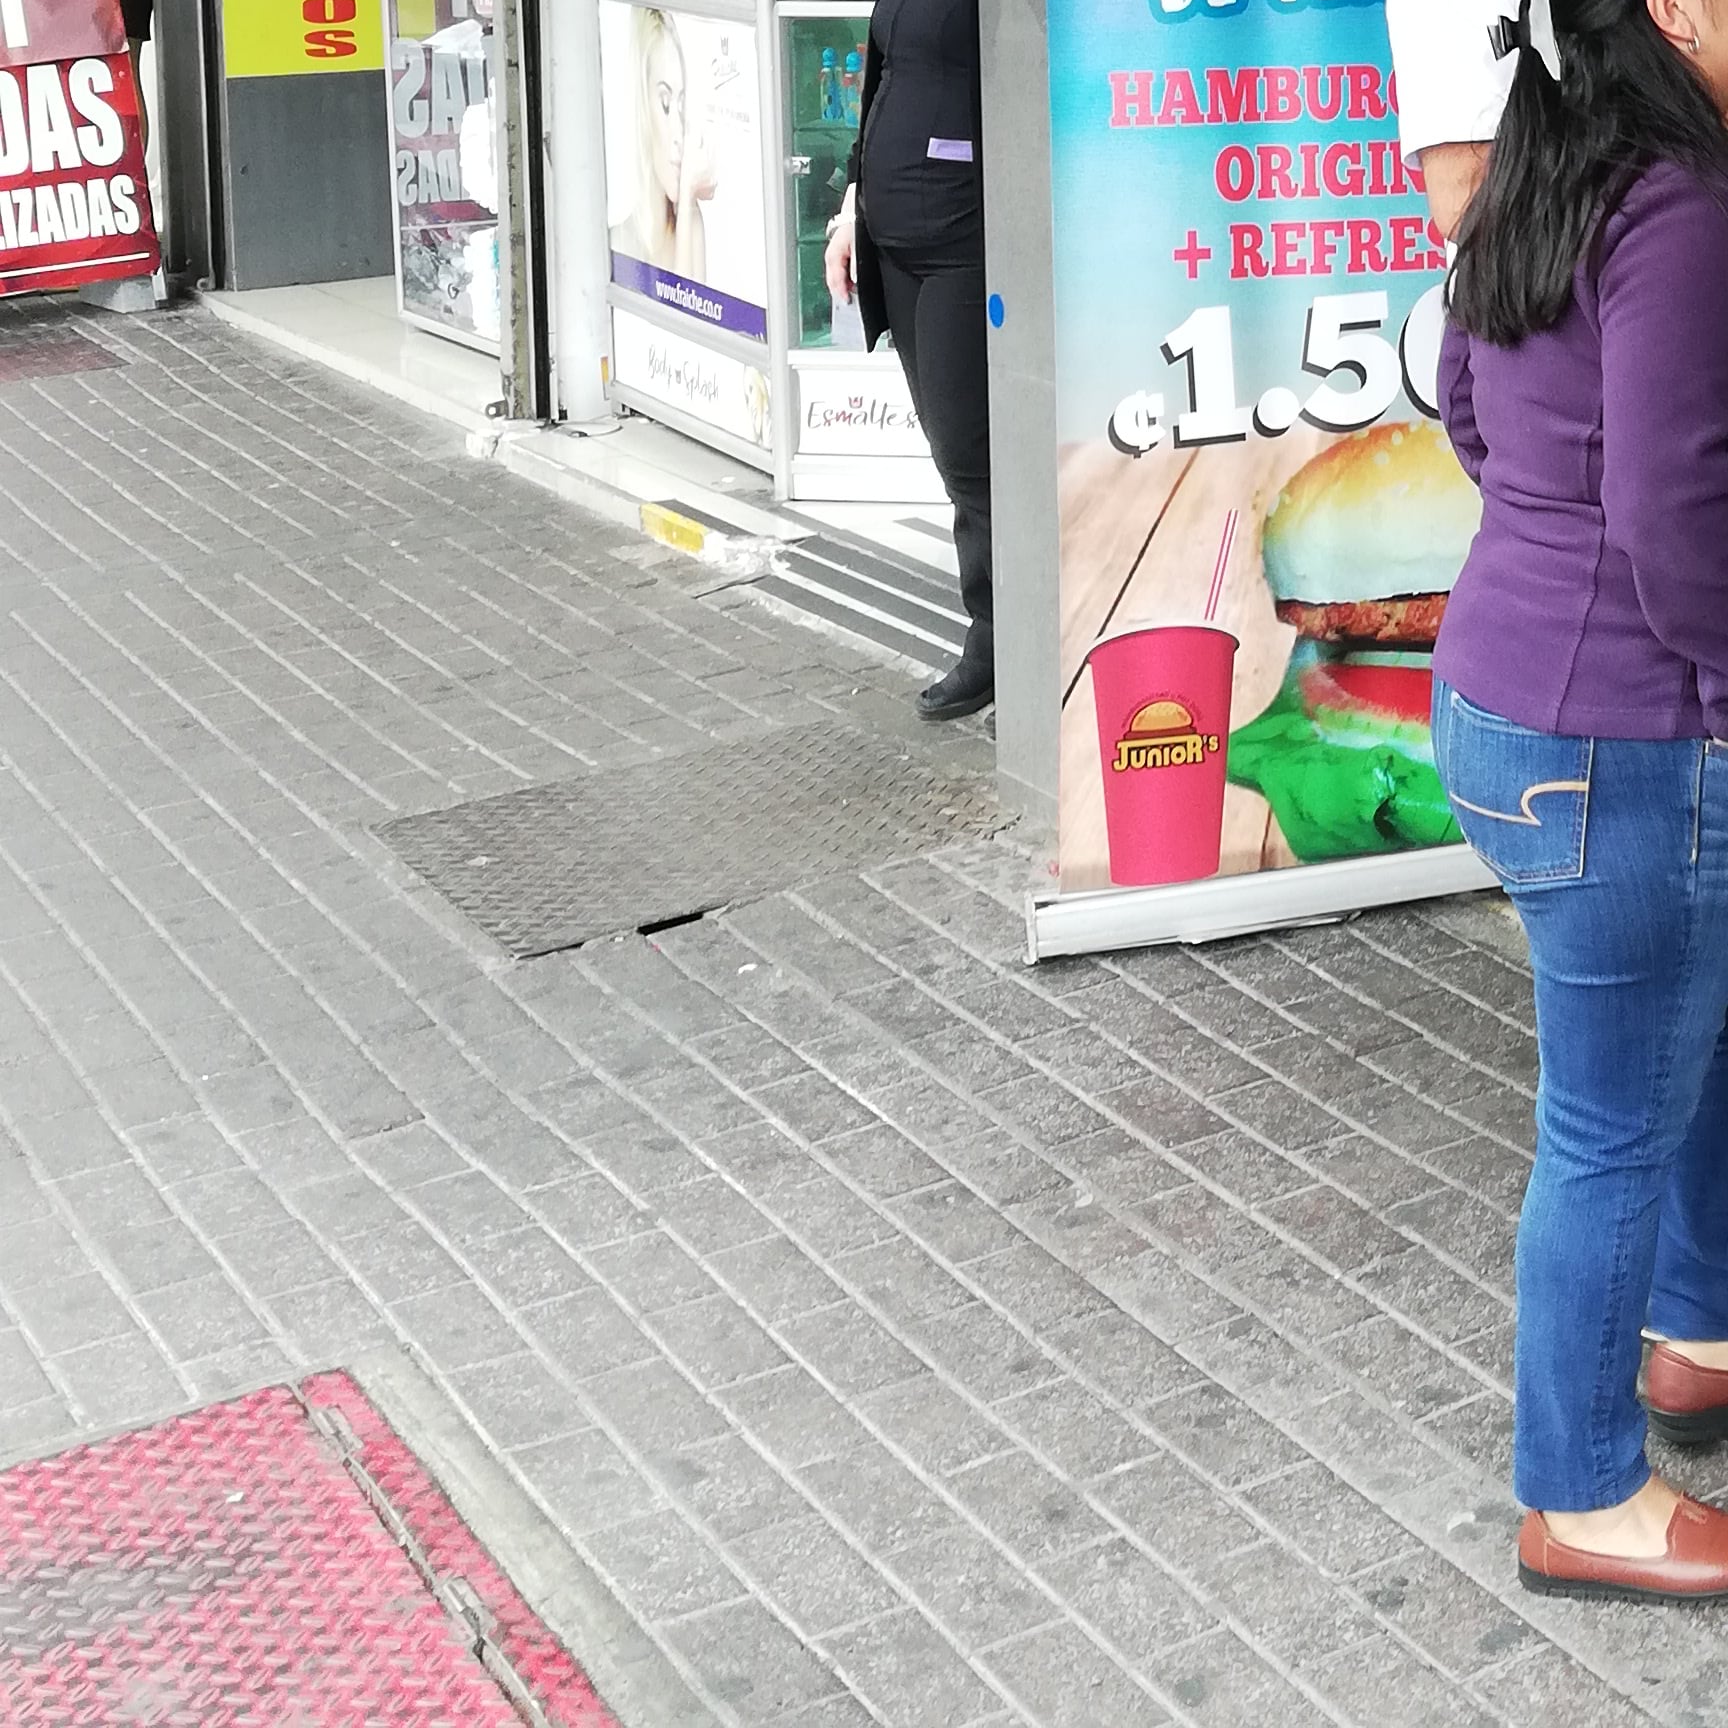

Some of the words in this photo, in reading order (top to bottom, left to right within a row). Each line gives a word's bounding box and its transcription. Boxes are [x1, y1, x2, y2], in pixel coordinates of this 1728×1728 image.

[0, 174, 140, 251] IZADAS
[1229, 216, 1449, 281] REFRES
[655, 279, 723, 321] www.fraiche.co.cr
[648, 343, 672, 392] Body
[683, 360, 719, 403] Splash
[807, 398, 919, 430] Esmaltes
